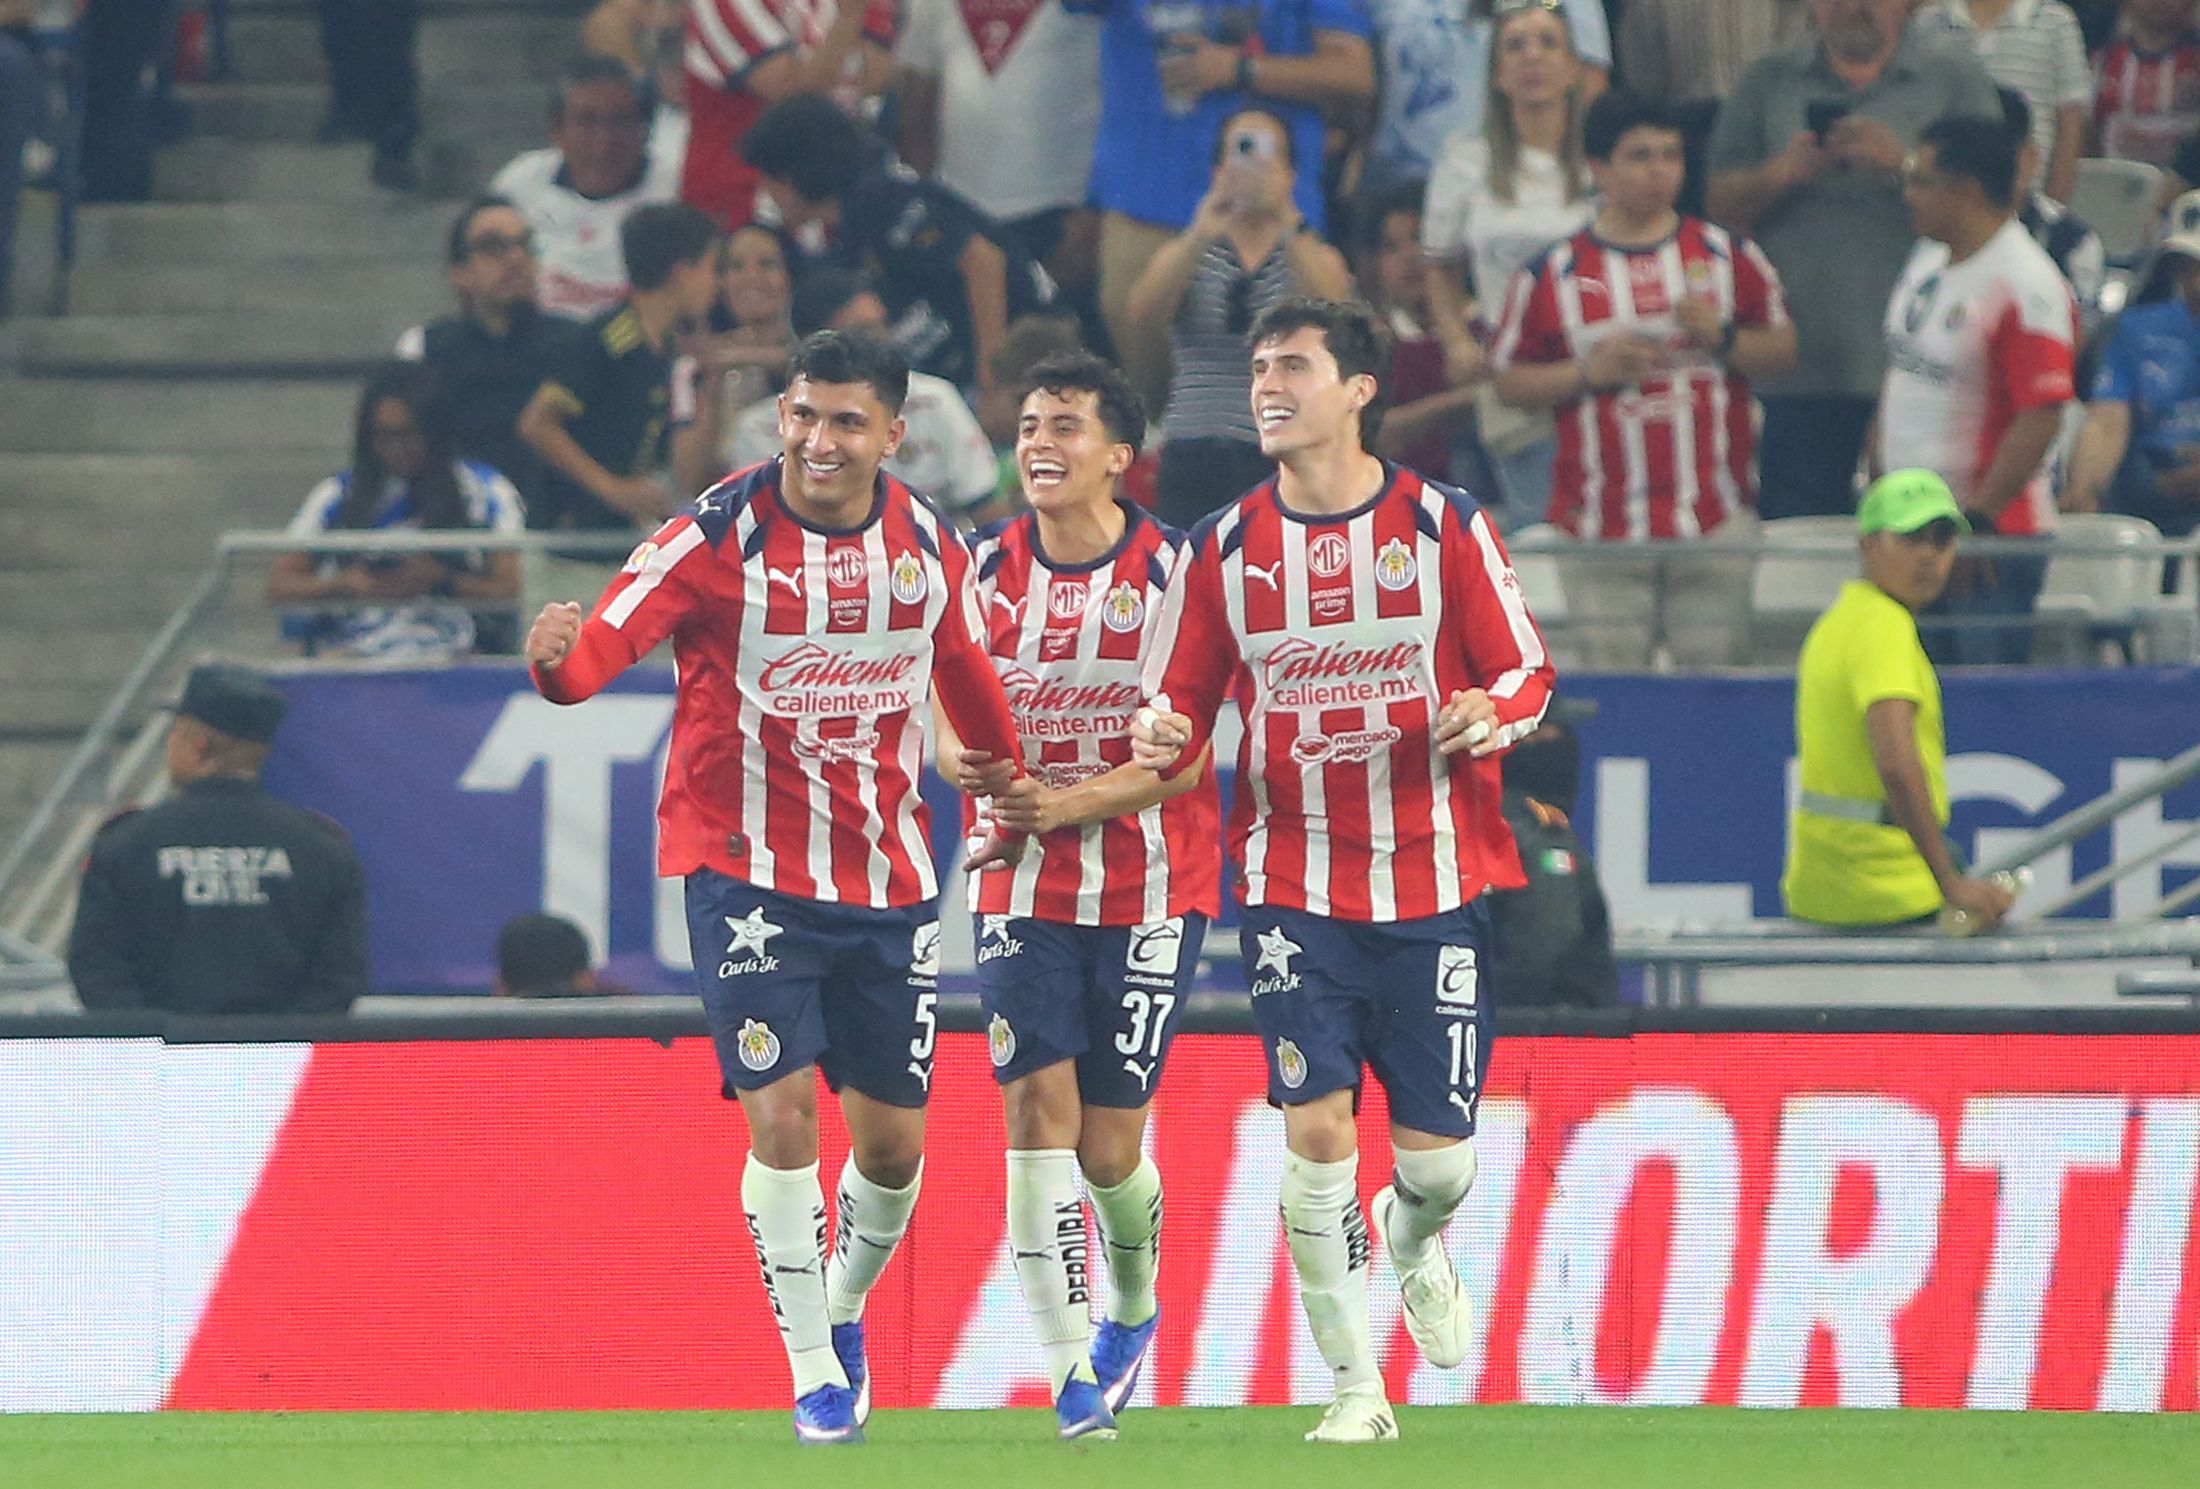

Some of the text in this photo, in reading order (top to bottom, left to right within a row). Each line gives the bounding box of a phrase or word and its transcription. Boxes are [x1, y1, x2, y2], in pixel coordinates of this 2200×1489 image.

[831, 552, 865, 584] MG
[1312, 537, 1345, 572] MG
[1054, 583, 1086, 615] MG
[1311, 586, 1350, 600] amazon
[1315, 598, 1346, 611] prime
[759, 642, 918, 692] Caliente
[1257, 636, 1424, 690] Caliente
[773, 690, 912, 713] caliente.mx
[1274, 676, 1419, 706] caliente.mx
[1014, 714, 1132, 736] liente.mx
[1335, 730, 1398, 745] mercado
[1336, 745, 1371, 758] pago
[1050, 763, 1109, 775] mercado
[157, 846, 293, 879] FUERZA
[911, 993, 937, 1060] 5
[1114, 990, 1176, 1057] 37
[1447, 1021, 1477, 1088] 19
